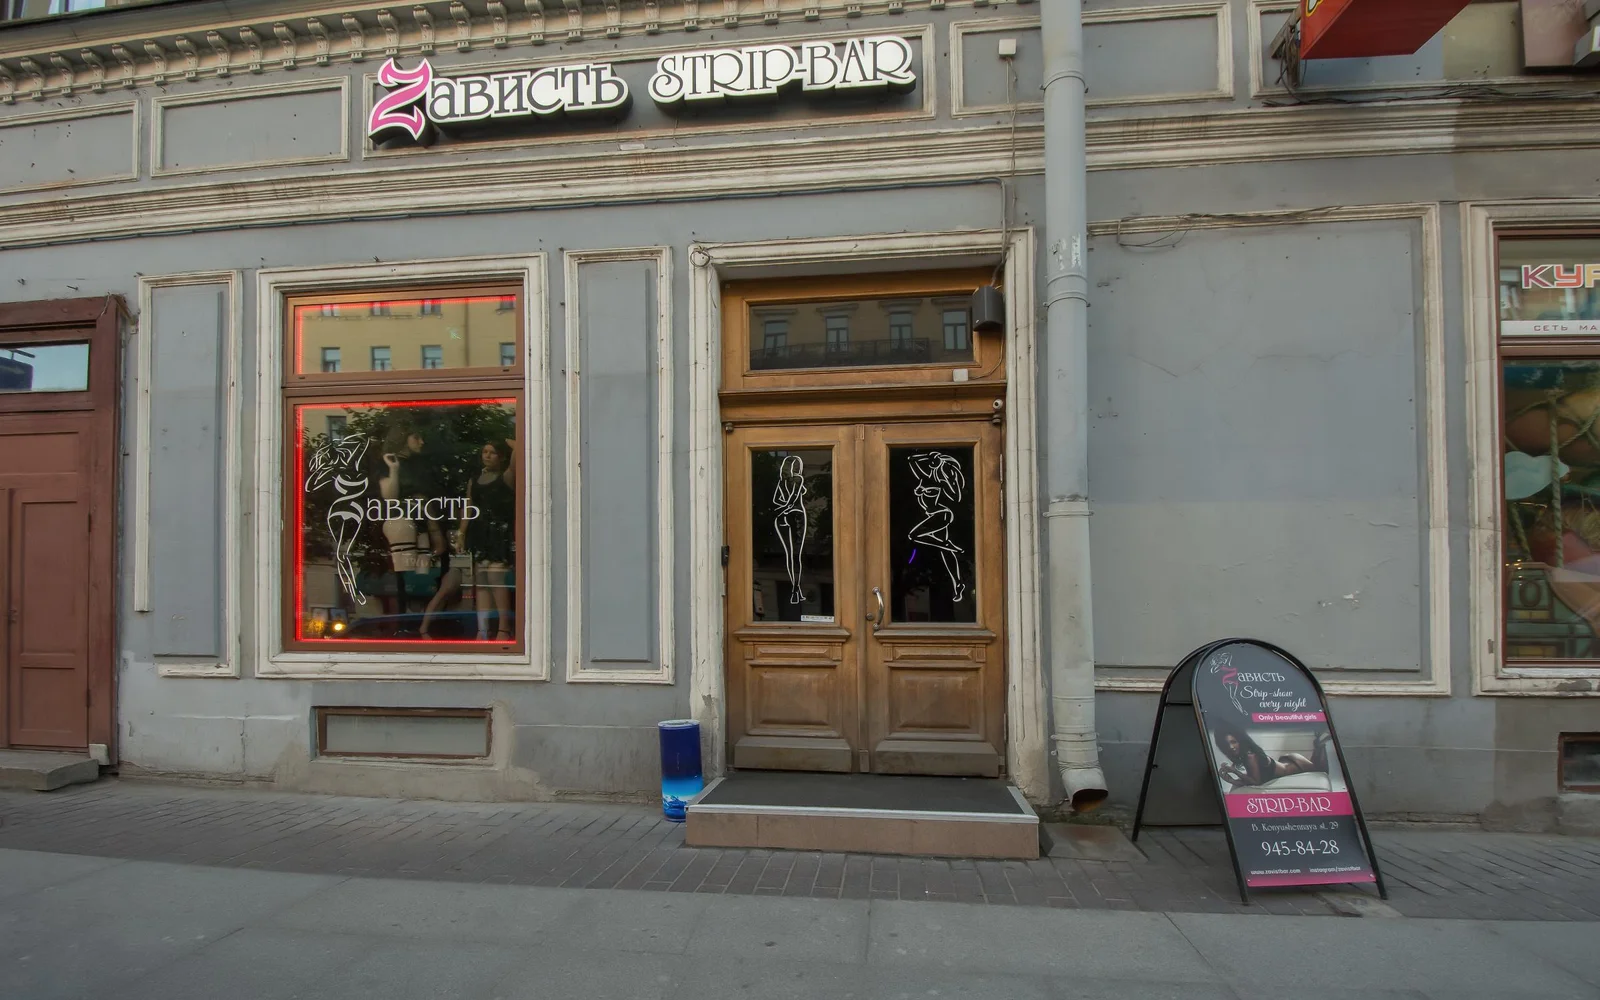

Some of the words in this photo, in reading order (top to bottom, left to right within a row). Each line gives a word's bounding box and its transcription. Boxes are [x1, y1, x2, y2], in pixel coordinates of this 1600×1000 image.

[652, 39, 917, 98] STRIP-BAR
[1259, 701, 1281, 712] every
[1284, 698, 1307, 712] night
[1246, 796, 1333, 814] STRIP-BAR
[1329, 821, 1339, 830] 29
[1261, 839, 1340, 857] 945-84-28
